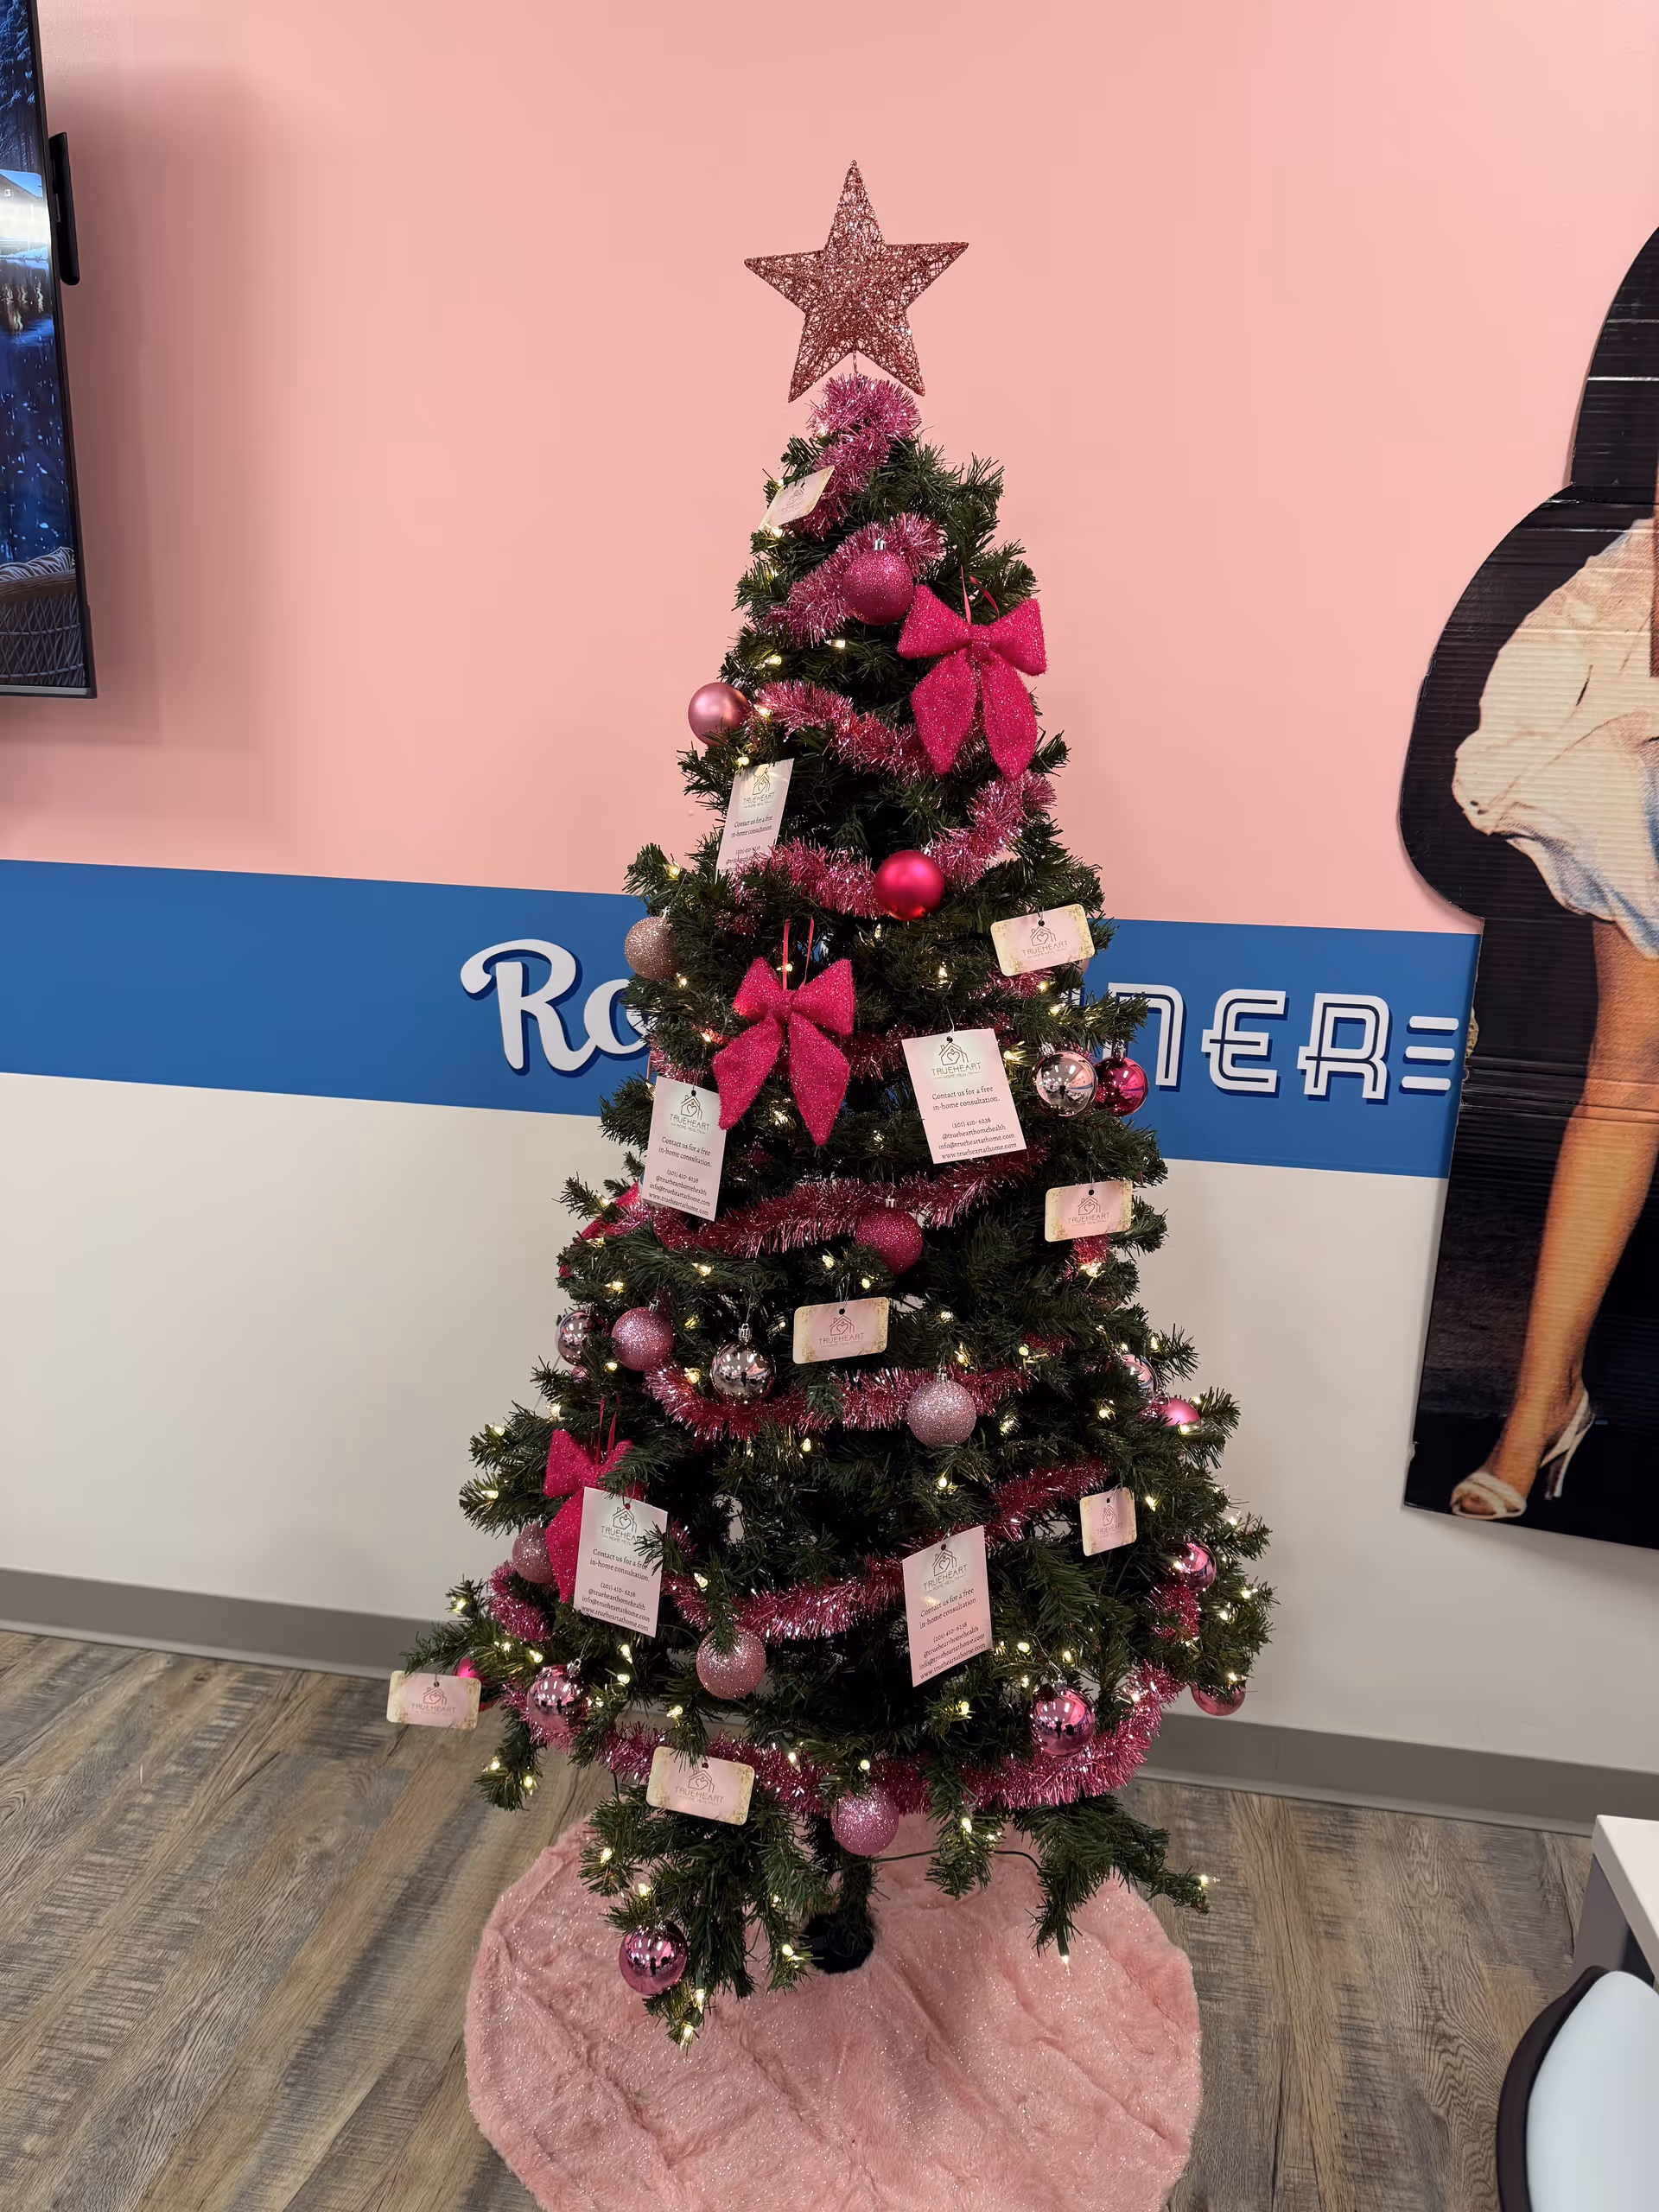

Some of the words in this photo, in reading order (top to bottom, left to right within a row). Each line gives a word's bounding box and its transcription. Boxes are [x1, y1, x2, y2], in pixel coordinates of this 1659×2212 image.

[743, 791, 775, 804] TRUEHEART
[1022, 940, 1067, 956] TRUEHEART
[1059, 982, 1391, 1105] NER
[931, 1062, 981, 1076] TRUEHEART
[960, 1096, 1000, 1107] consultation.
[671, 1114, 709, 1131] TRUEHEART
[943, 1124, 1006, 1140] @truehearthomehealth
[662, 1137, 681, 1147] Contact
[938, 1134, 1014, 1150] info@trueheartathome.com
[941, 1142, 1017, 1159] www.trueheartathome.com
[658, 1146, 680, 1157] in-home
[680, 1154, 712, 1167] consultation.
[656, 1175, 706, 1195] @truehearthomehealth
[1068, 1213, 1109, 1224] TRUEHEART
[819, 1333, 864, 1344] TRUEHEART
[601, 1526, 640, 1542] TRUEHEA
[593, 1549, 614, 1560] Contact
[590, 1558, 613, 1570] in-home
[614, 1566, 650, 1581] consultation.
[924, 1564, 967, 1590] TRUEHEART
[582, 1595, 650, 1622] info@trueheartathome.com
[588, 1589, 645, 1611] @truehearthomehealth
[582, 1606, 648, 1631] www.trueheartathome.com
[919, 1614, 942, 1629] in-home
[943, 1598, 977, 1617] consultation.
[921, 1604, 941, 1617] Contact
[933, 1632, 944, 1643] (201)
[957, 1622, 967, 1630] 6238
[924, 1626, 978, 1658] @truehearthomehealth
[919, 1634, 984, 1670] info@trueheartathome.com
[920, 1643, 985, 1679] www.trueheartathome.com
[411, 1703, 455, 1713] TRUEHEART
[675, 1786, 724, 1803] TRUEHEART
